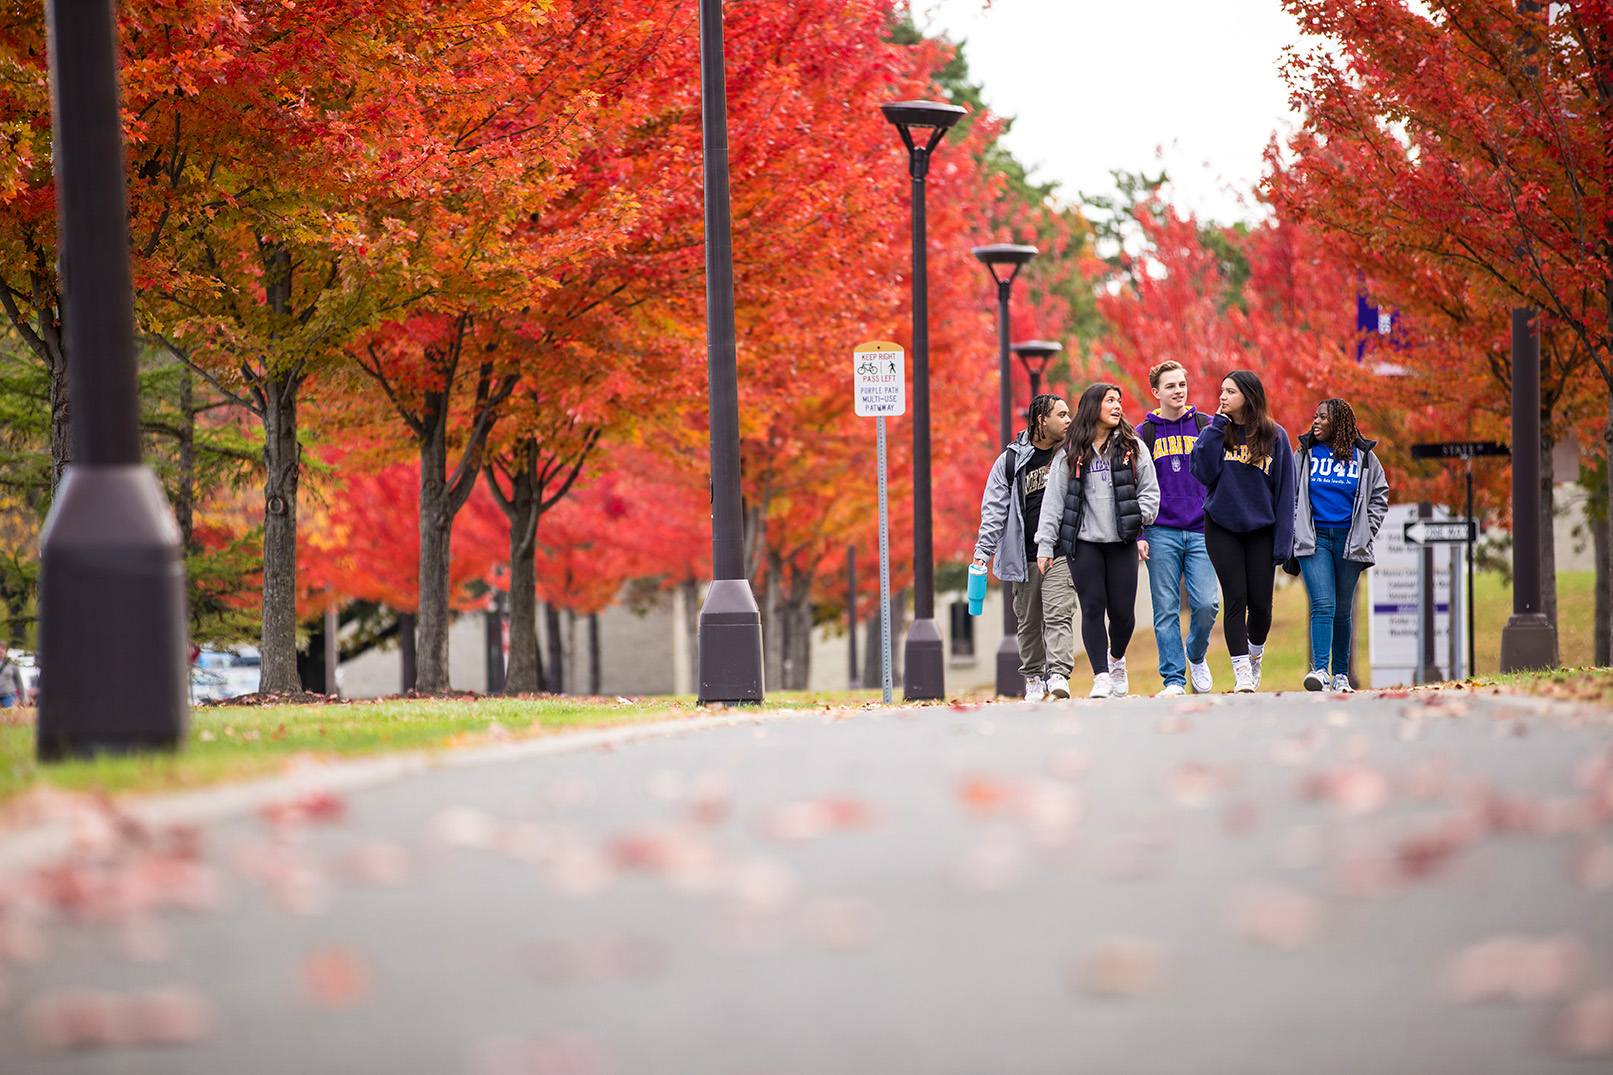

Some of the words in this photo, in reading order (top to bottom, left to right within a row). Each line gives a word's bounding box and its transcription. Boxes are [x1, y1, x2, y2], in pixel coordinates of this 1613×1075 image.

[862, 353, 877, 361] KEEP
[879, 352, 896, 360] RIGHT
[863, 375, 880, 383] PASS
[881, 374, 896, 382] LEFT
[884, 386, 899, 394] PATH
[862, 395, 897, 403] MULTI-USE
[1153, 435, 1199, 461] ALBAN
[1425, 525, 1445, 540] ONE
[1448, 525, 1469, 540] WAY
